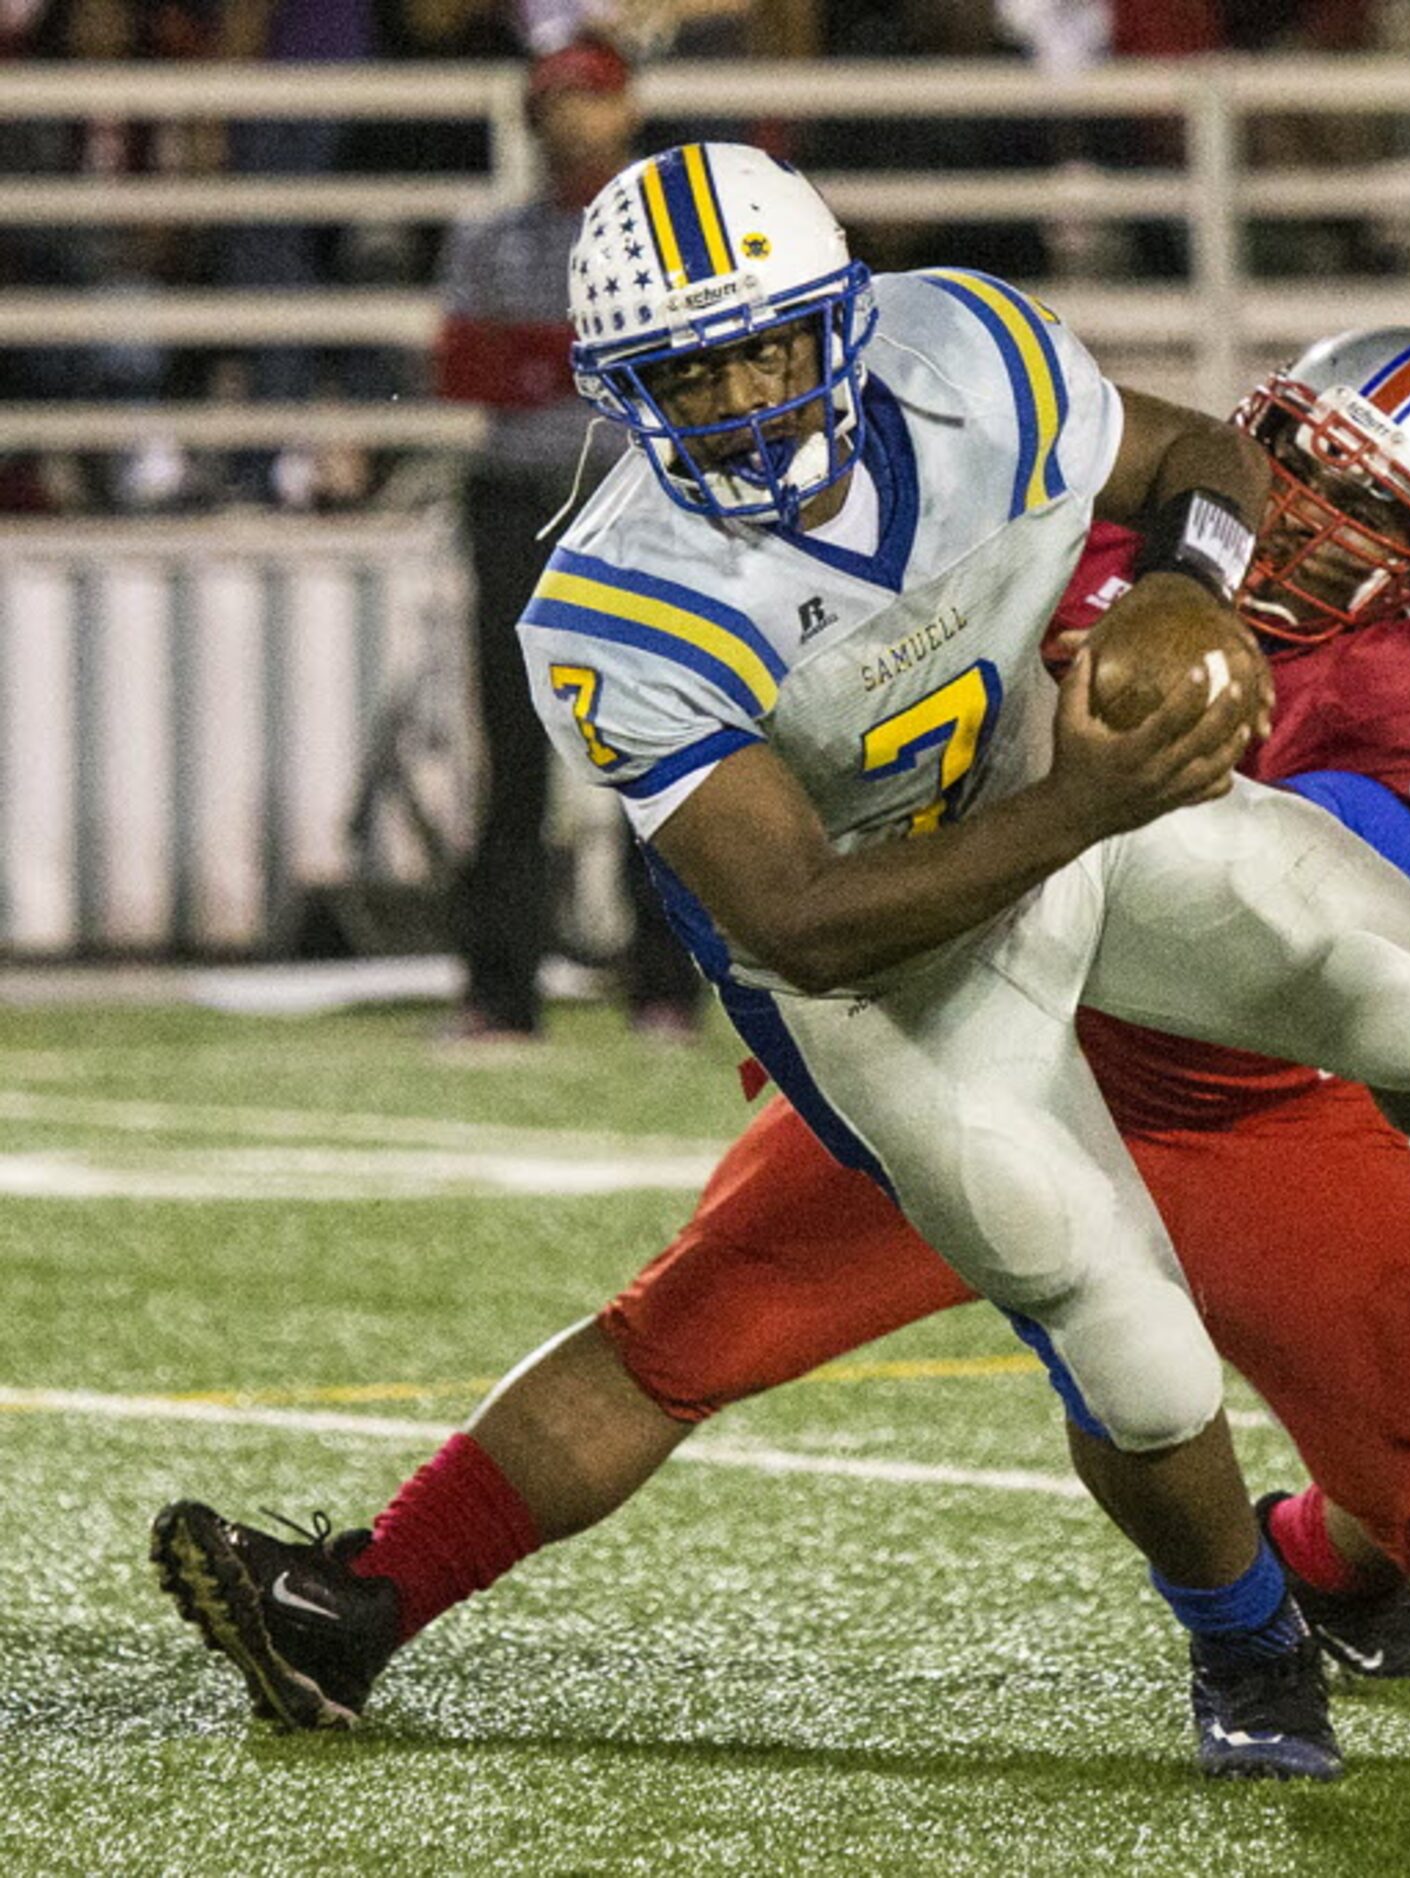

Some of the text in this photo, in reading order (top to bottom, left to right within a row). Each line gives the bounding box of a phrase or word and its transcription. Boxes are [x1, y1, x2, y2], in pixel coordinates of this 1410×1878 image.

[860, 607, 968, 692] SAMUELL
[549, 663, 632, 774] 7
[858, 657, 1004, 838] 7
